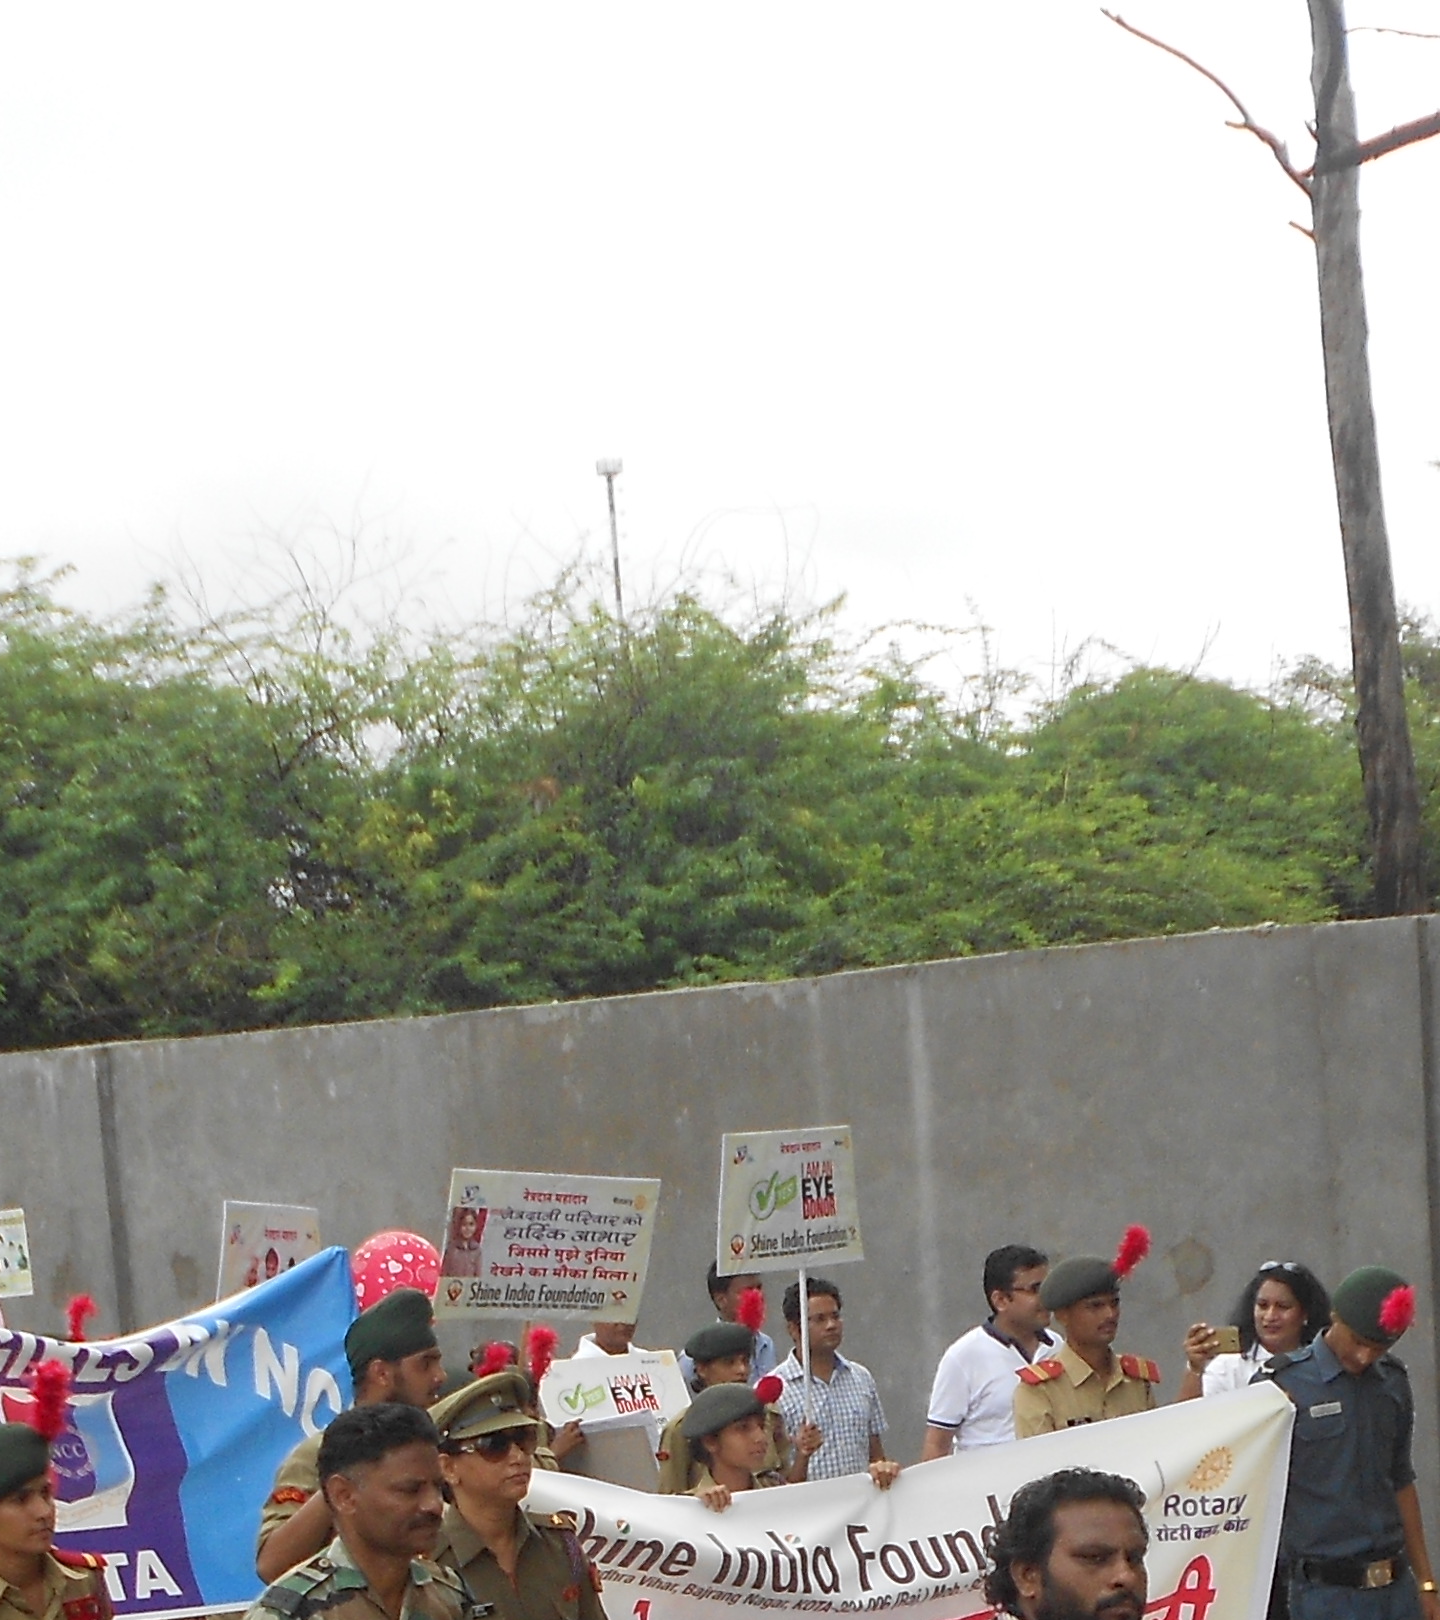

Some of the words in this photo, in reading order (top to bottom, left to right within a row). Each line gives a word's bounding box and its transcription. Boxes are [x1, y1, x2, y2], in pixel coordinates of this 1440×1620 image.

[801, 1176, 834, 1198] EYE
[751, 1234, 778, 1252] Shine
[469, 1282, 501, 1301] Shine
[504, 1282, 535, 1302] India
[538, 1284, 605, 1305] Foundation
[253, 1327, 354, 1438] NC
[614, 1374, 632, 1388] AM
[610, 1384, 653, 1401] EYE
[616, 1396, 659, 1414] DONOR
[1163, 1493, 1247, 1517] Rotary
[1156, 1523, 1192, 1542] रोटरी
[706, 1529, 842, 1595] India
[846, 1493, 1003, 1592] Found
[101, 1550, 183, 1601] TA
[639, 1575, 679, 1593] Vihar,
[681, 1582, 743, 1606] Bajrang
